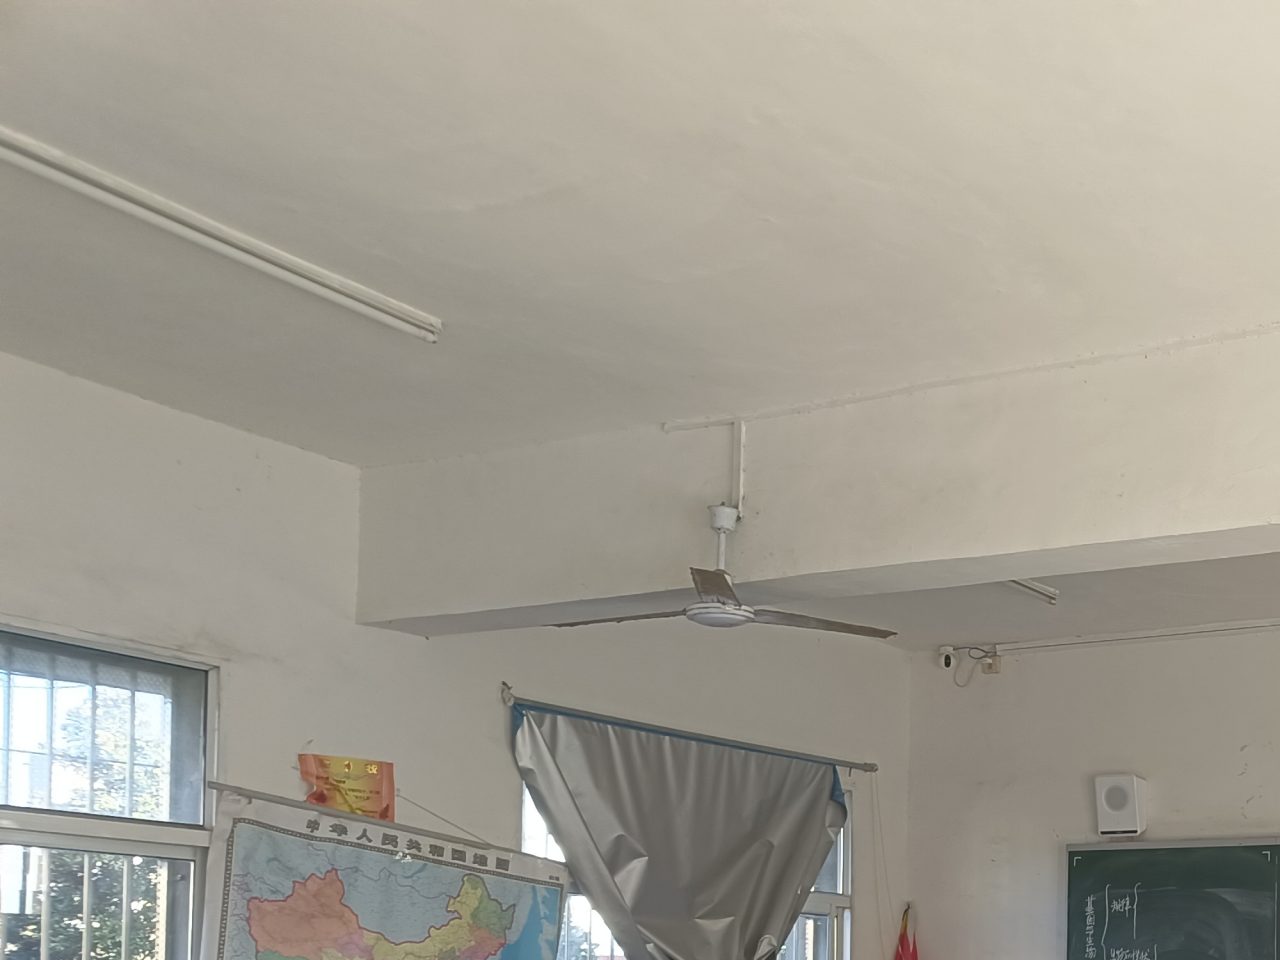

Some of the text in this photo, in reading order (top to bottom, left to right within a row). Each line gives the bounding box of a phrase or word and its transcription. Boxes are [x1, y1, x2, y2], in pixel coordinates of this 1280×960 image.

[306, 818, 511, 872] 中华人民共和国地图
